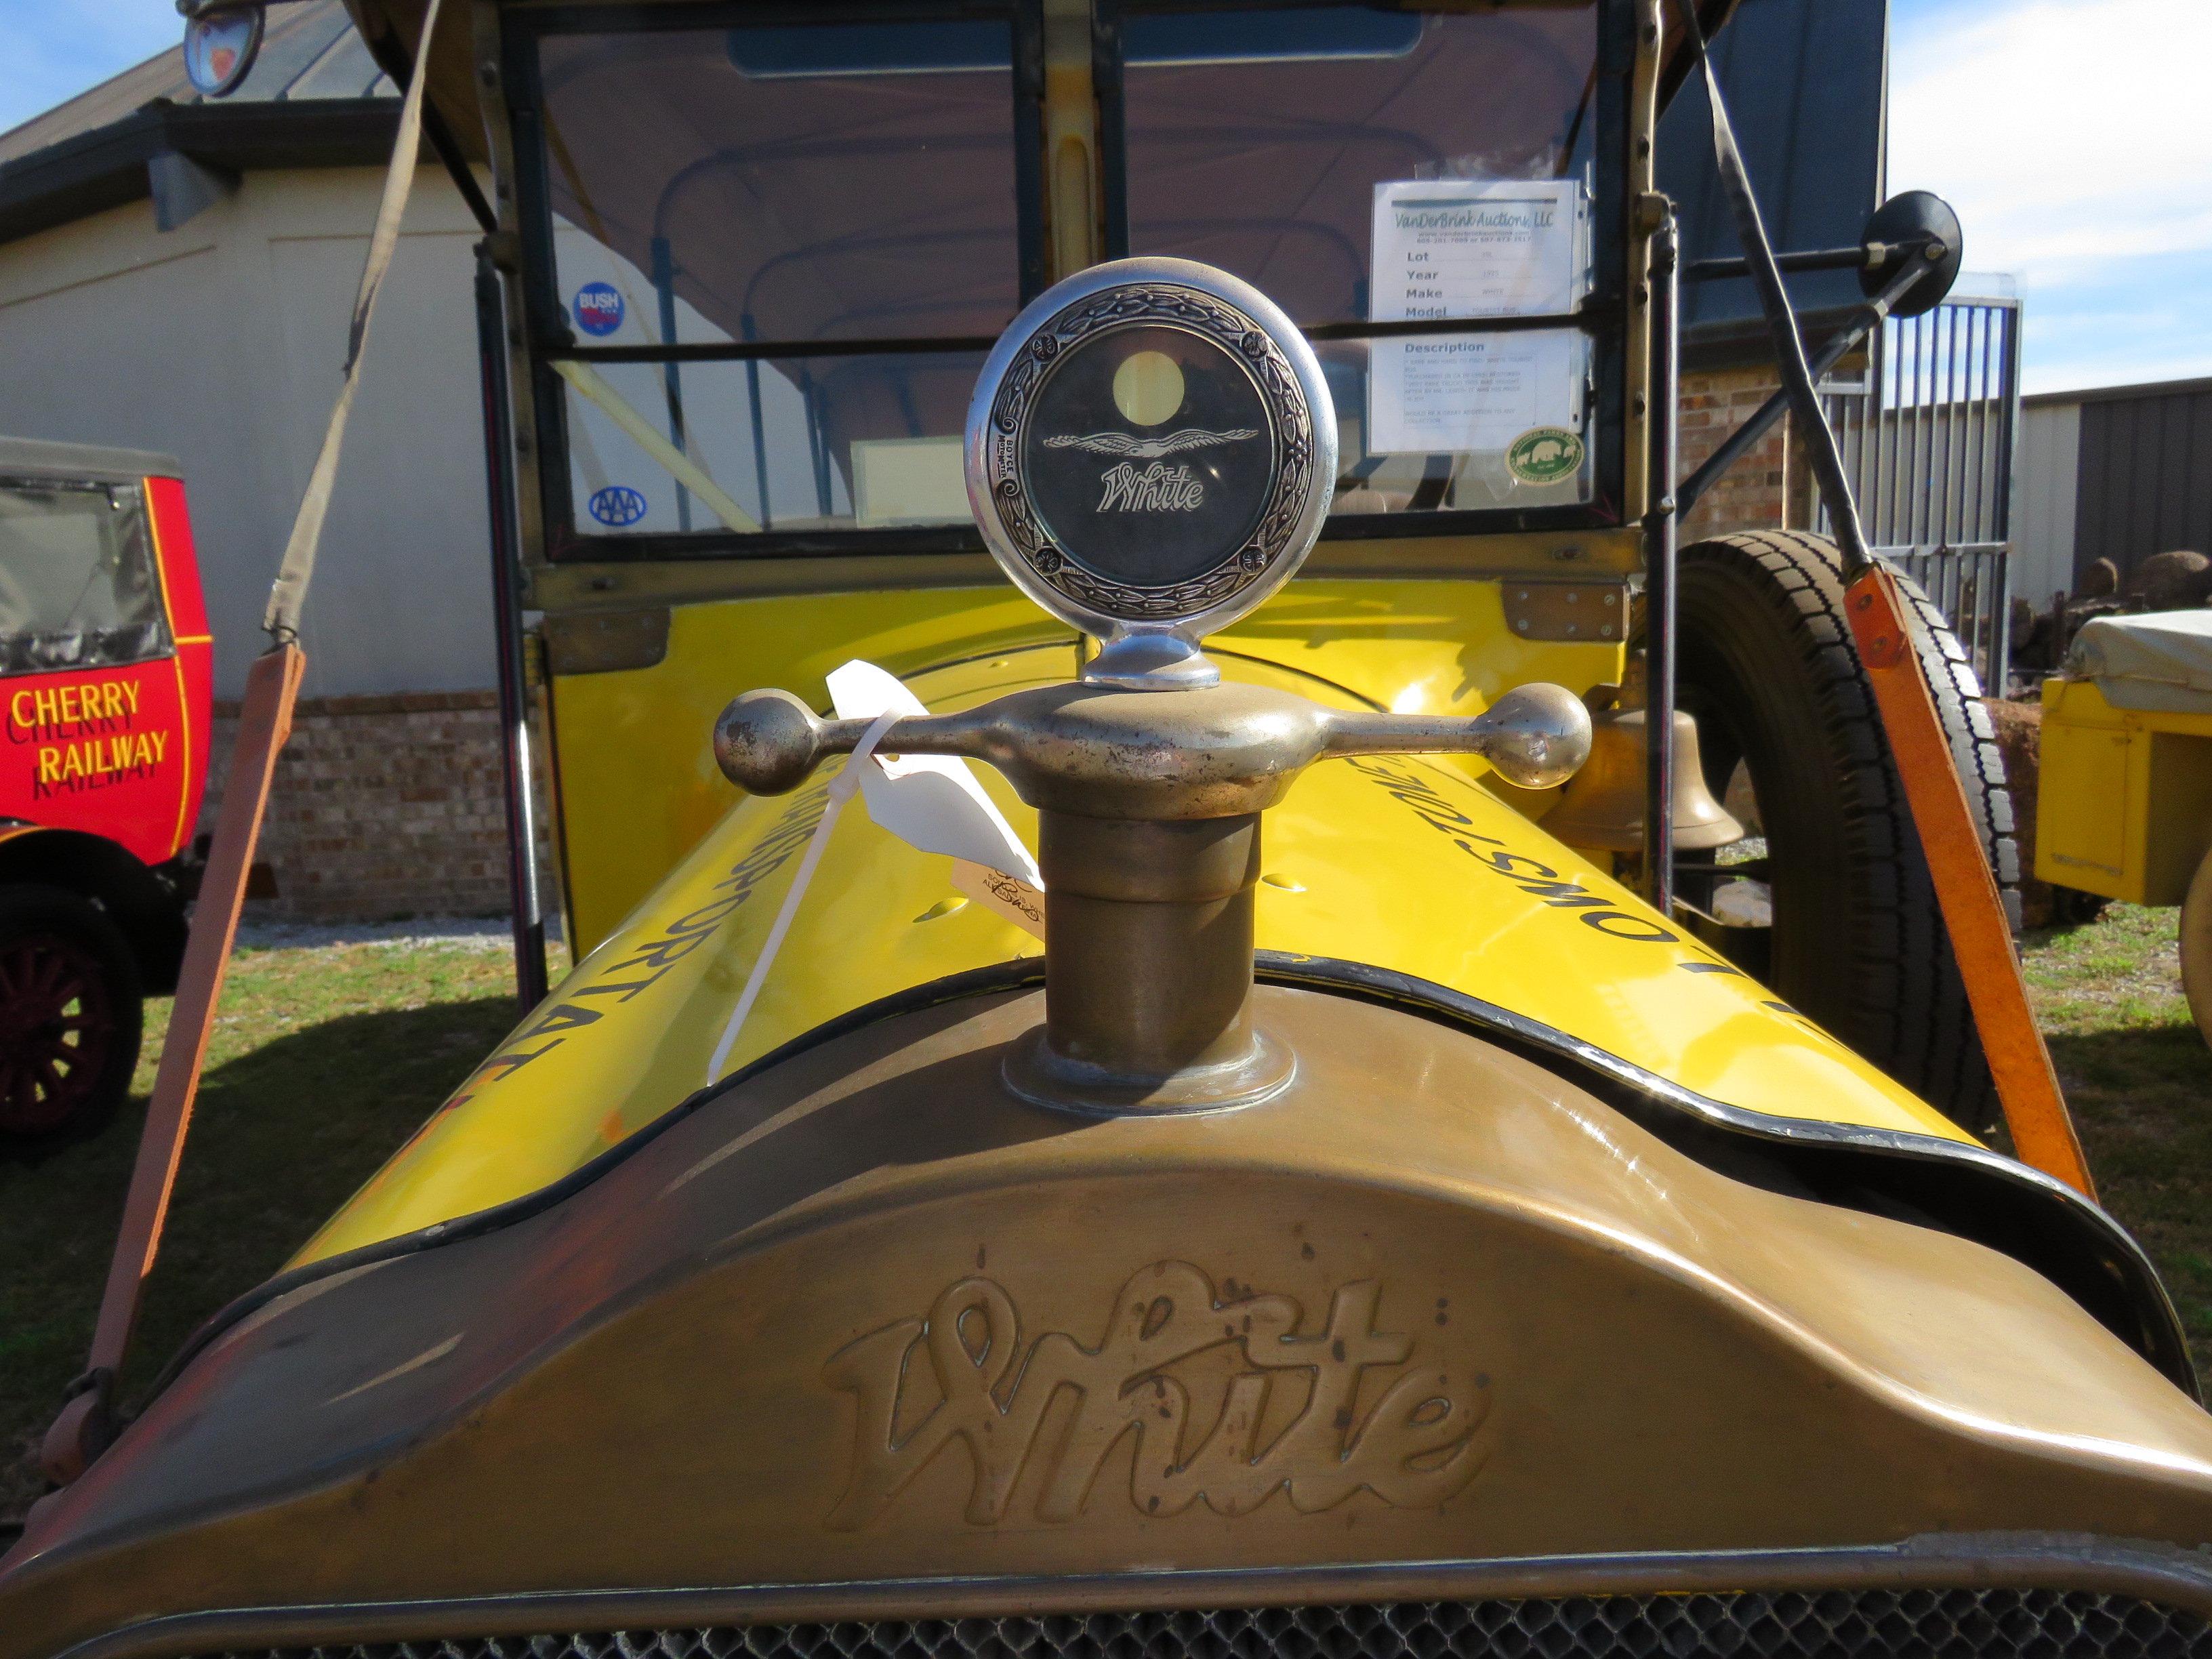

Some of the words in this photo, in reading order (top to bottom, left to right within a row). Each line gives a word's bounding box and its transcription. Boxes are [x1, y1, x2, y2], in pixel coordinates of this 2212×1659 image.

[1395, 209, 1476, 229] VanDerBrink
[1534, 211, 1554, 228] LLC
[1407, 251, 1429, 262] Lot
[1407, 270, 1439, 280] Year
[579, 292, 619, 309] BUSH
[1406, 288, 1442, 298] Make
[1406, 306, 1447, 317] Model
[1405, 342, 1485, 354] Description
[1095, 462, 1204, 513] White
[594, 487, 642, 526] AAA
[10, 679, 140, 729] CHERRY
[39, 729, 167, 785] RAILWAY
[820, 1258, 1491, 1533] White
